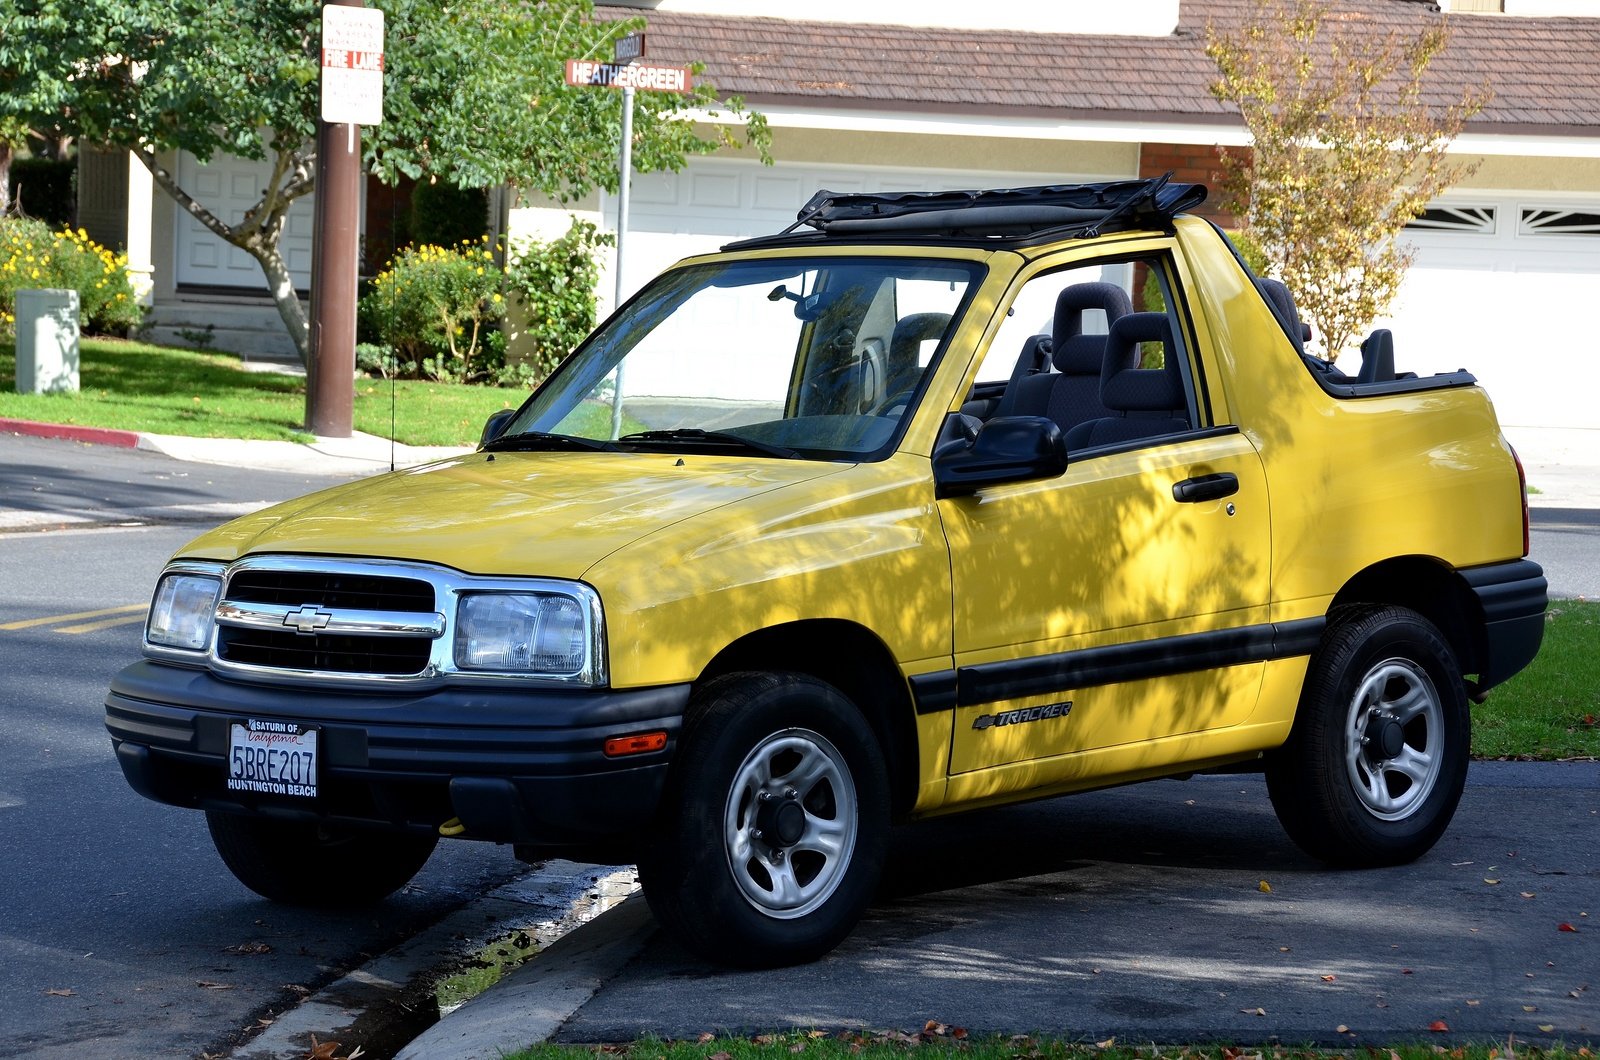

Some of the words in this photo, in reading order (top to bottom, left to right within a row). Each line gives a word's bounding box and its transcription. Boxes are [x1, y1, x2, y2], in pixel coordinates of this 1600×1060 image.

[324, 49, 348, 67] FIRE
[353, 51, 381, 71] LANE
[572, 61, 685, 91] HEATHERGREEN
[998, 702, 1072, 725] TRACKER
[256, 721, 286, 732] SATURN
[288, 724, 298, 733] OF
[248, 730, 304, 747] California
[233, 745, 313, 785] 5BRE207
[228, 778, 286, 795] HUNTINGTON
[288, 784, 317, 797] BEACH
